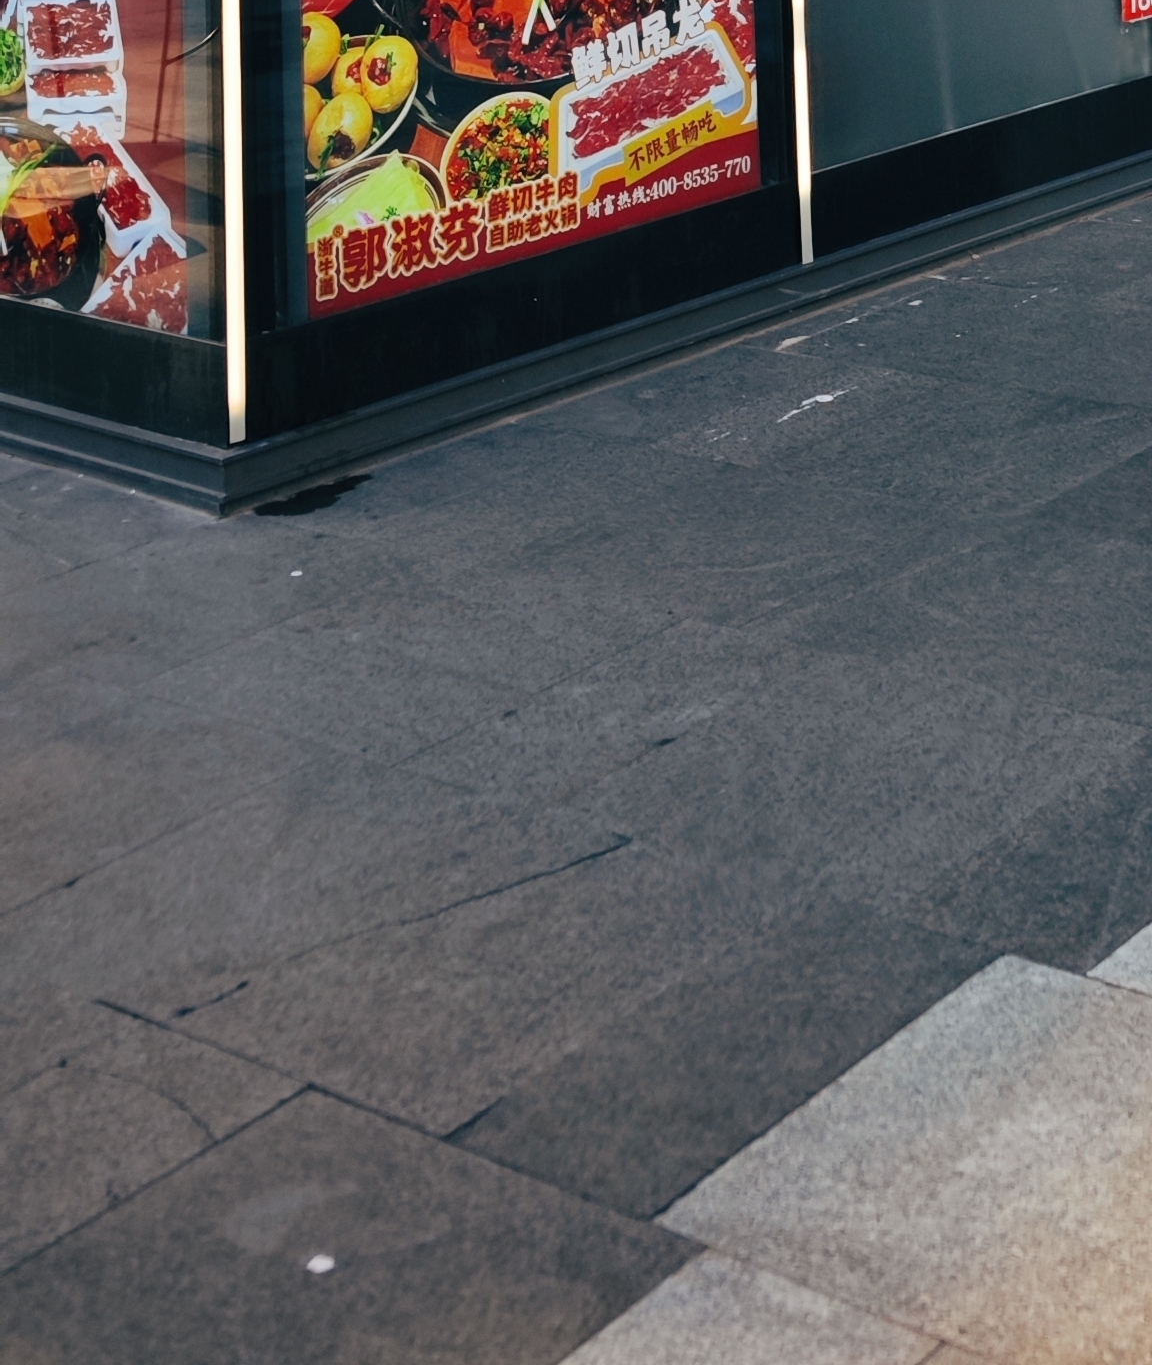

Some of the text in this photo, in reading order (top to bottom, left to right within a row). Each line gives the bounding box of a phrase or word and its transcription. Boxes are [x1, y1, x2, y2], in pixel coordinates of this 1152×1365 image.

[628, 110, 718, 172] 不限量畅吃
[487, 171, 580, 225] 鲜切牛肉
[586, 154, 751, 220] 财富热线:400-8535-770
[341, 197, 482, 292] 郭淑芬
[488, 203, 580, 251] 自助老火锅
